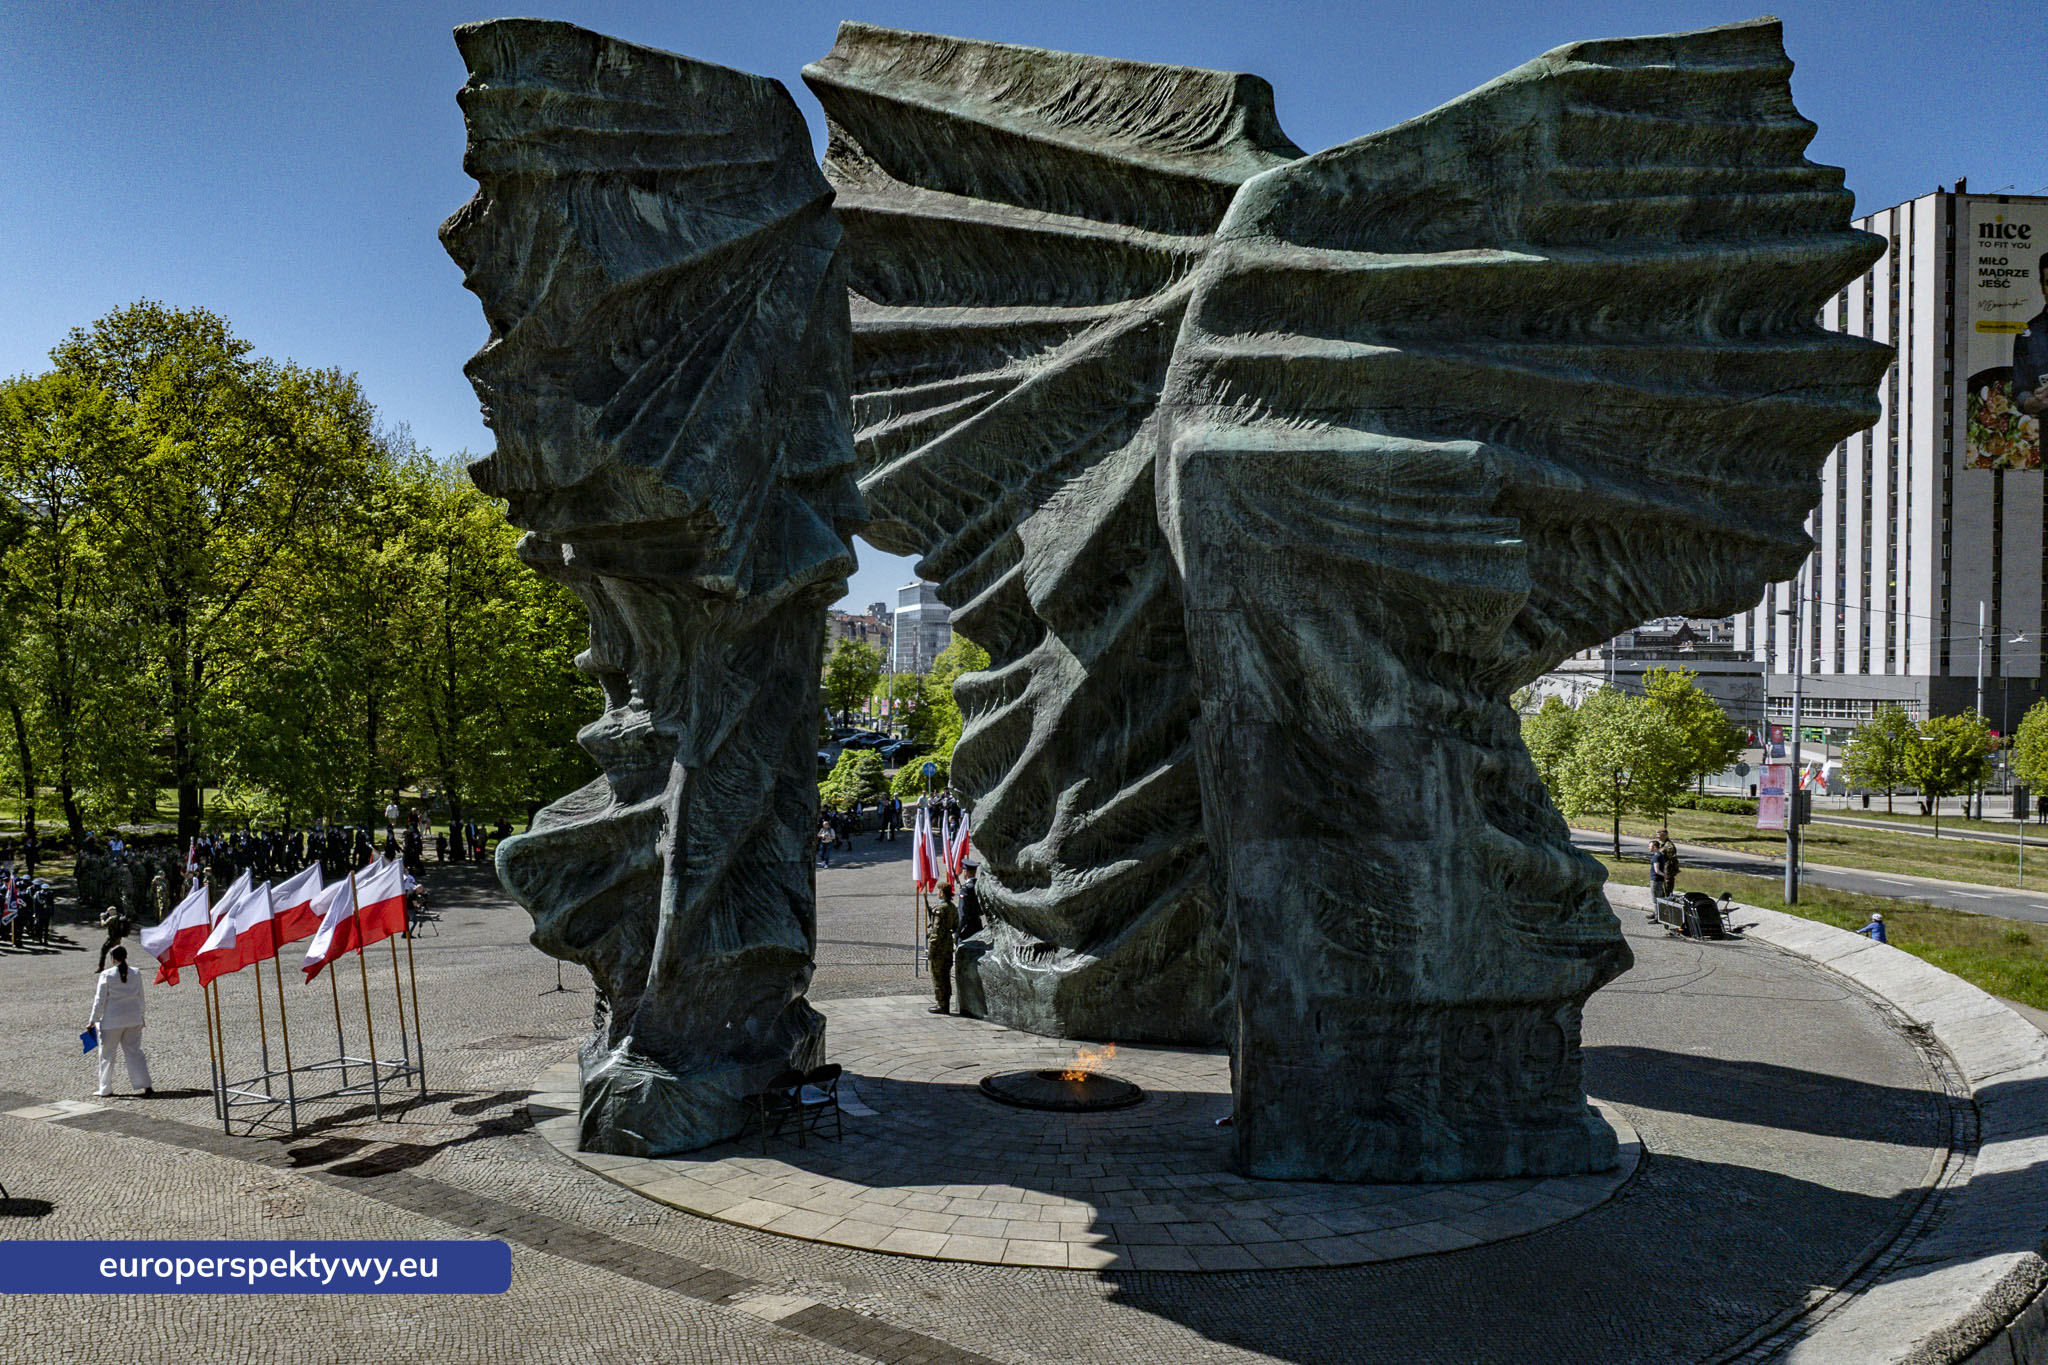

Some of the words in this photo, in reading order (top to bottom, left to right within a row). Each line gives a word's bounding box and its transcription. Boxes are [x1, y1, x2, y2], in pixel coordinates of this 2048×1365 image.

[1978, 214, 2031, 240] nice
[1979, 257, 2008, 266] MIŁO
[1978, 268, 2029, 278] MĄDRZE
[1978, 278, 2011, 288] JEŚĆ
